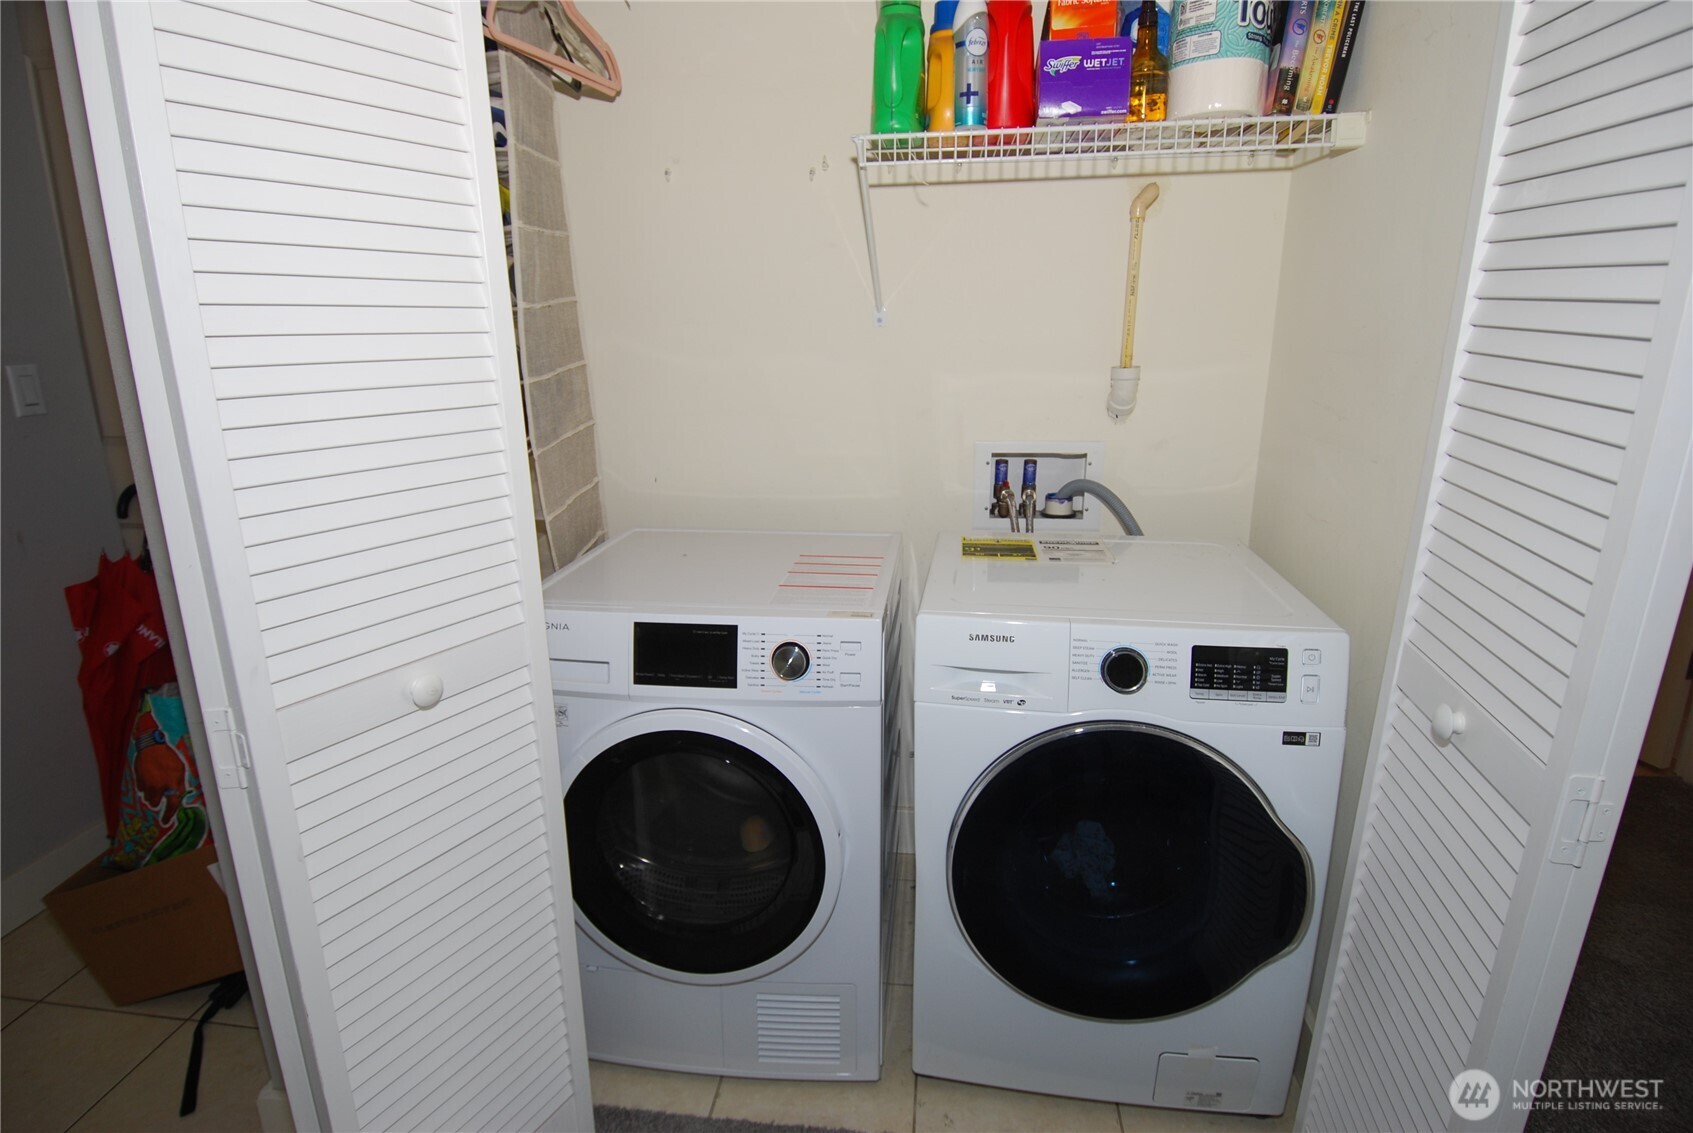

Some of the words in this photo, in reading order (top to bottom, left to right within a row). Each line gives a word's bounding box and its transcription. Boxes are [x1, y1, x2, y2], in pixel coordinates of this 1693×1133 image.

[1330, 18, 1339, 40] CRIME
[1349, 13, 1357, 27] LAST
[1341, 28, 1353, 58] POLICEMAN
[1044, 57, 1080, 73] Swiffer
[1322, 44, 1333, 73] TREVOR
[1283, 49, 1299, 91] Becoming
[1317, 75, 1326, 96] NOAH
[969, 633, 1015, 643] SAMSUNG
[951, 695, 981, 703] SuperSpeed
